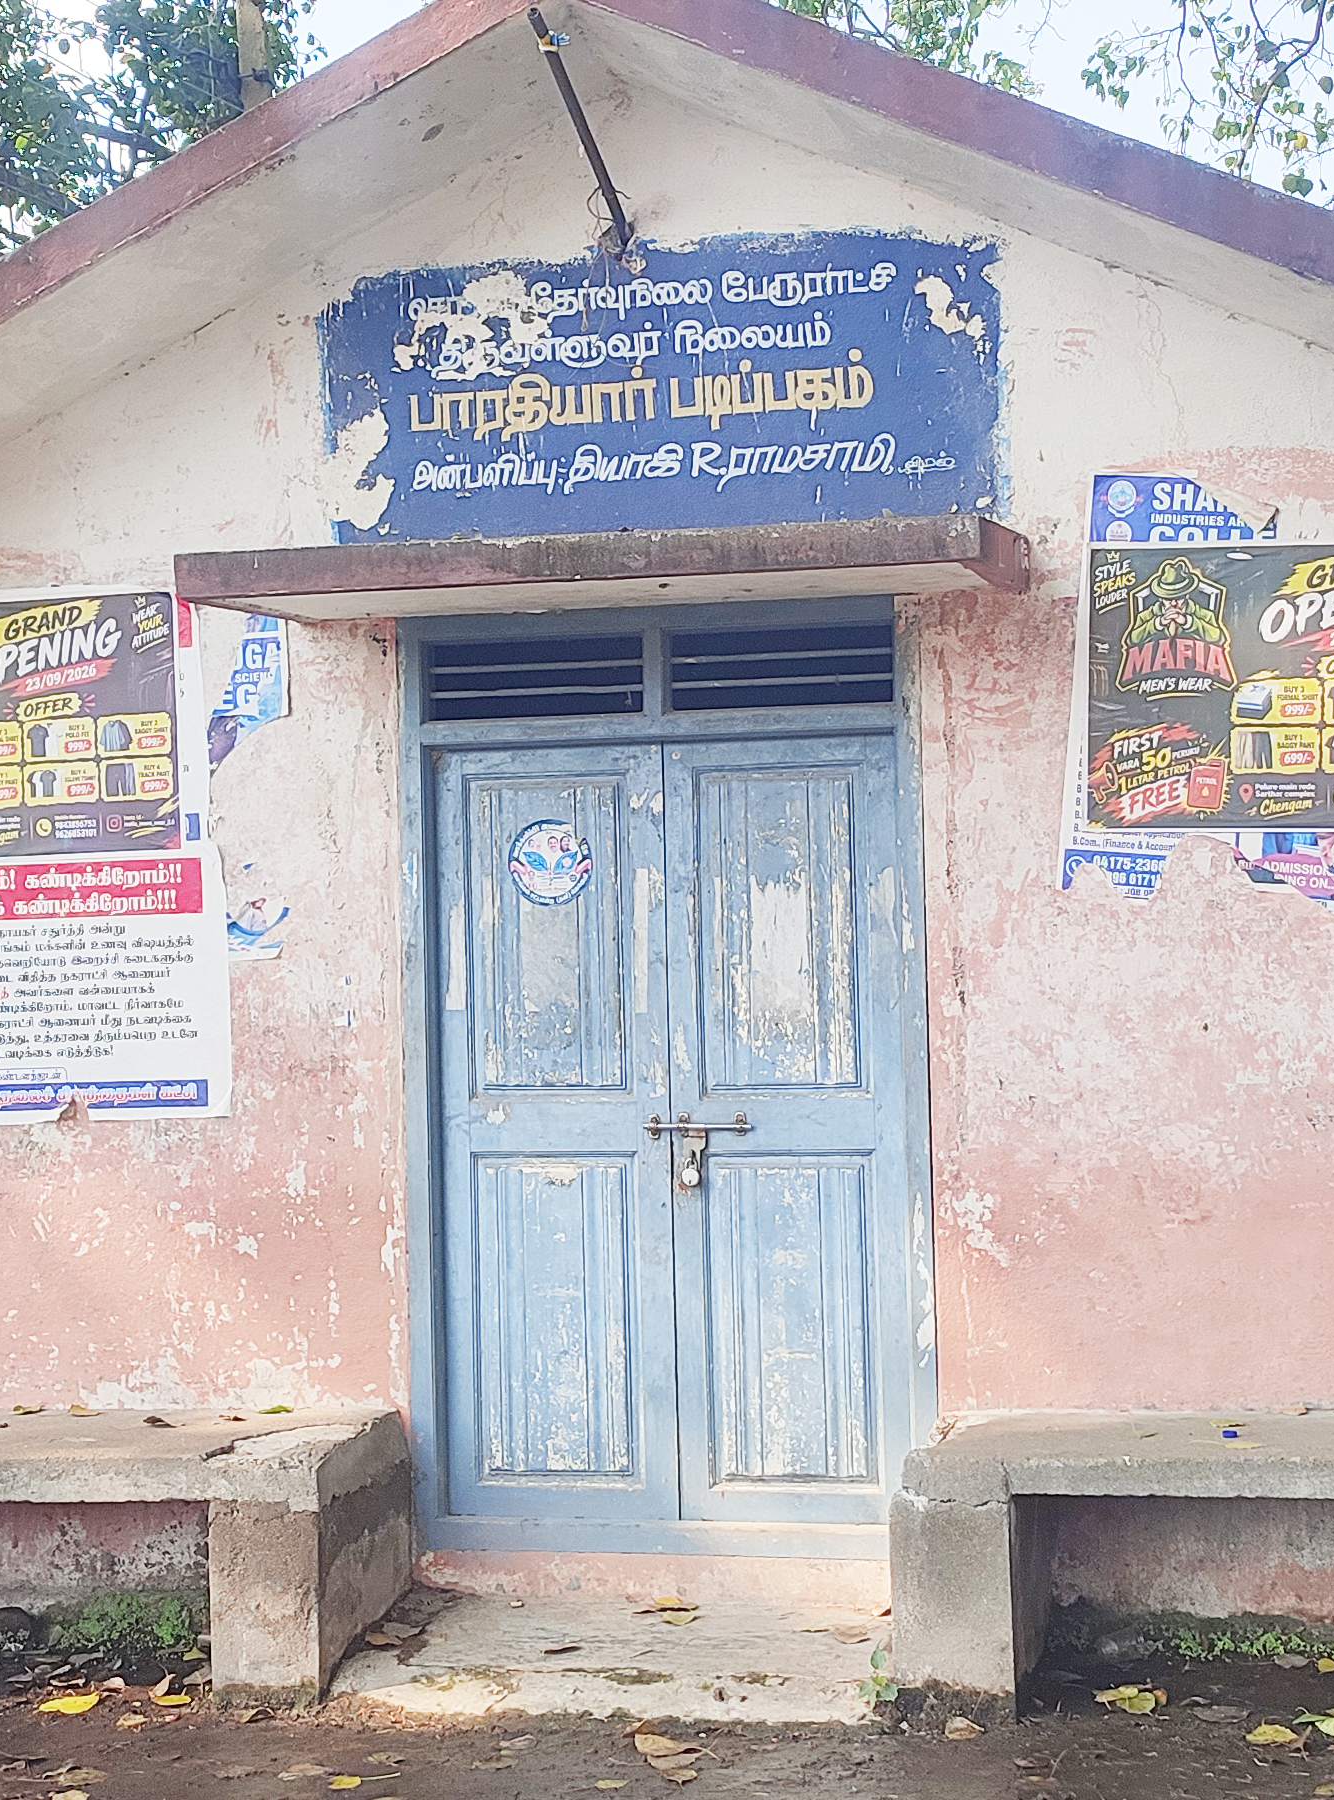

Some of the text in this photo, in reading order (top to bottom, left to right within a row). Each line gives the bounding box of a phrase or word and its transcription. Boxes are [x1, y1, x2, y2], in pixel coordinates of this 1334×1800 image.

[674, 311, 832, 354] நிலையம்
[408, 348, 874, 442] பாரதியார் படிப்பகம்
[564, 442, 684, 494] தியாகி
[1150, 513, 1225, 526] INDUSTRIES
[1094, 559, 1131, 582] STYLE
[1093, 572, 1136, 597] SPEAKS
[1095, 588, 1128, 609] LOUDER
[4, 605, 83, 641] GRAND
[131, 602, 160, 624] WEAR
[137, 614, 164, 634] YOUR
[131, 623, 170, 649] ATTITUDE
[1122, 638, 1233, 682] MAFIA
[25, 663, 97, 692] 23/09/2026
[1139, 677, 1213, 694] MEN'S WEAR
[23, 697, 73, 718] OFFER
[1284, 704, 1313, 715] 999/-
[1113, 730, 1163, 759] FIRST
[1116, 758, 1140, 772] VARA
[1141, 746, 1172, 772] 50
[1283, 753, 1312, 764] 699/-
[1118, 763, 1191, 795] 1 LETAR PETROL
[1128, 779, 1181, 815] FREE
[1260, 798, 1313, 815] Chengam
[1136, 840, 1143, 849] &
[24, 862, 182, 891] கண்டிக்கிறோம்!!
[12, 889, 177, 916] கண்டிக்கிறோம்!!!
[89, 922, 126, 936] அன்று
[35, 939, 86, 952] மக்களின்
[90, 940, 127, 951] உணவு
[60, 968, 108, 983] நகராட்சி
[112, 966, 171, 981] ஆணையர்
[77, 1000, 121, 1011] மாவட்ட
[38, 1014, 96, 1028] ஆணையர்
[125, 1012, 192, 1027] நடவடிக்கை
